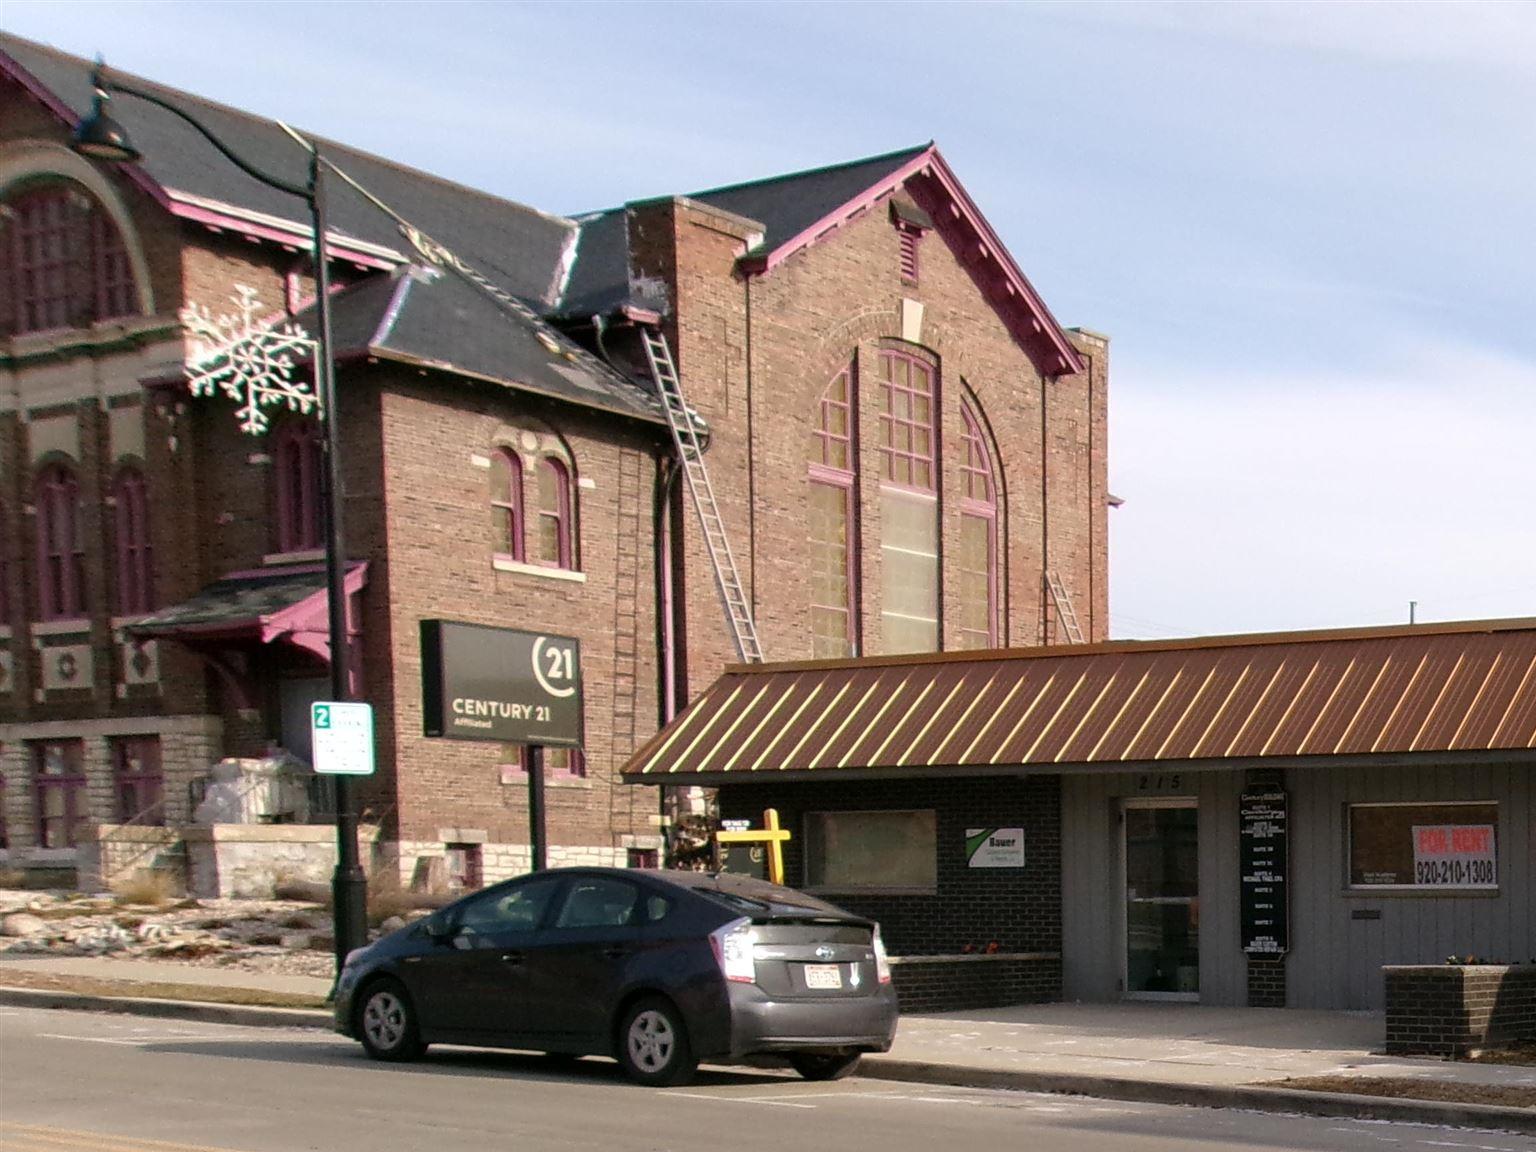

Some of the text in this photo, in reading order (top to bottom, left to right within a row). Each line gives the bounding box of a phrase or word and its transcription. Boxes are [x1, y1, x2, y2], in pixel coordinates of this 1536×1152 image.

[316, 707, 329, 726] 2
[452, 698, 550, 721] CENTURY 21
[1453, 827, 1491, 853] RENT
[1416, 860, 1494, 884] 920-210-1308
